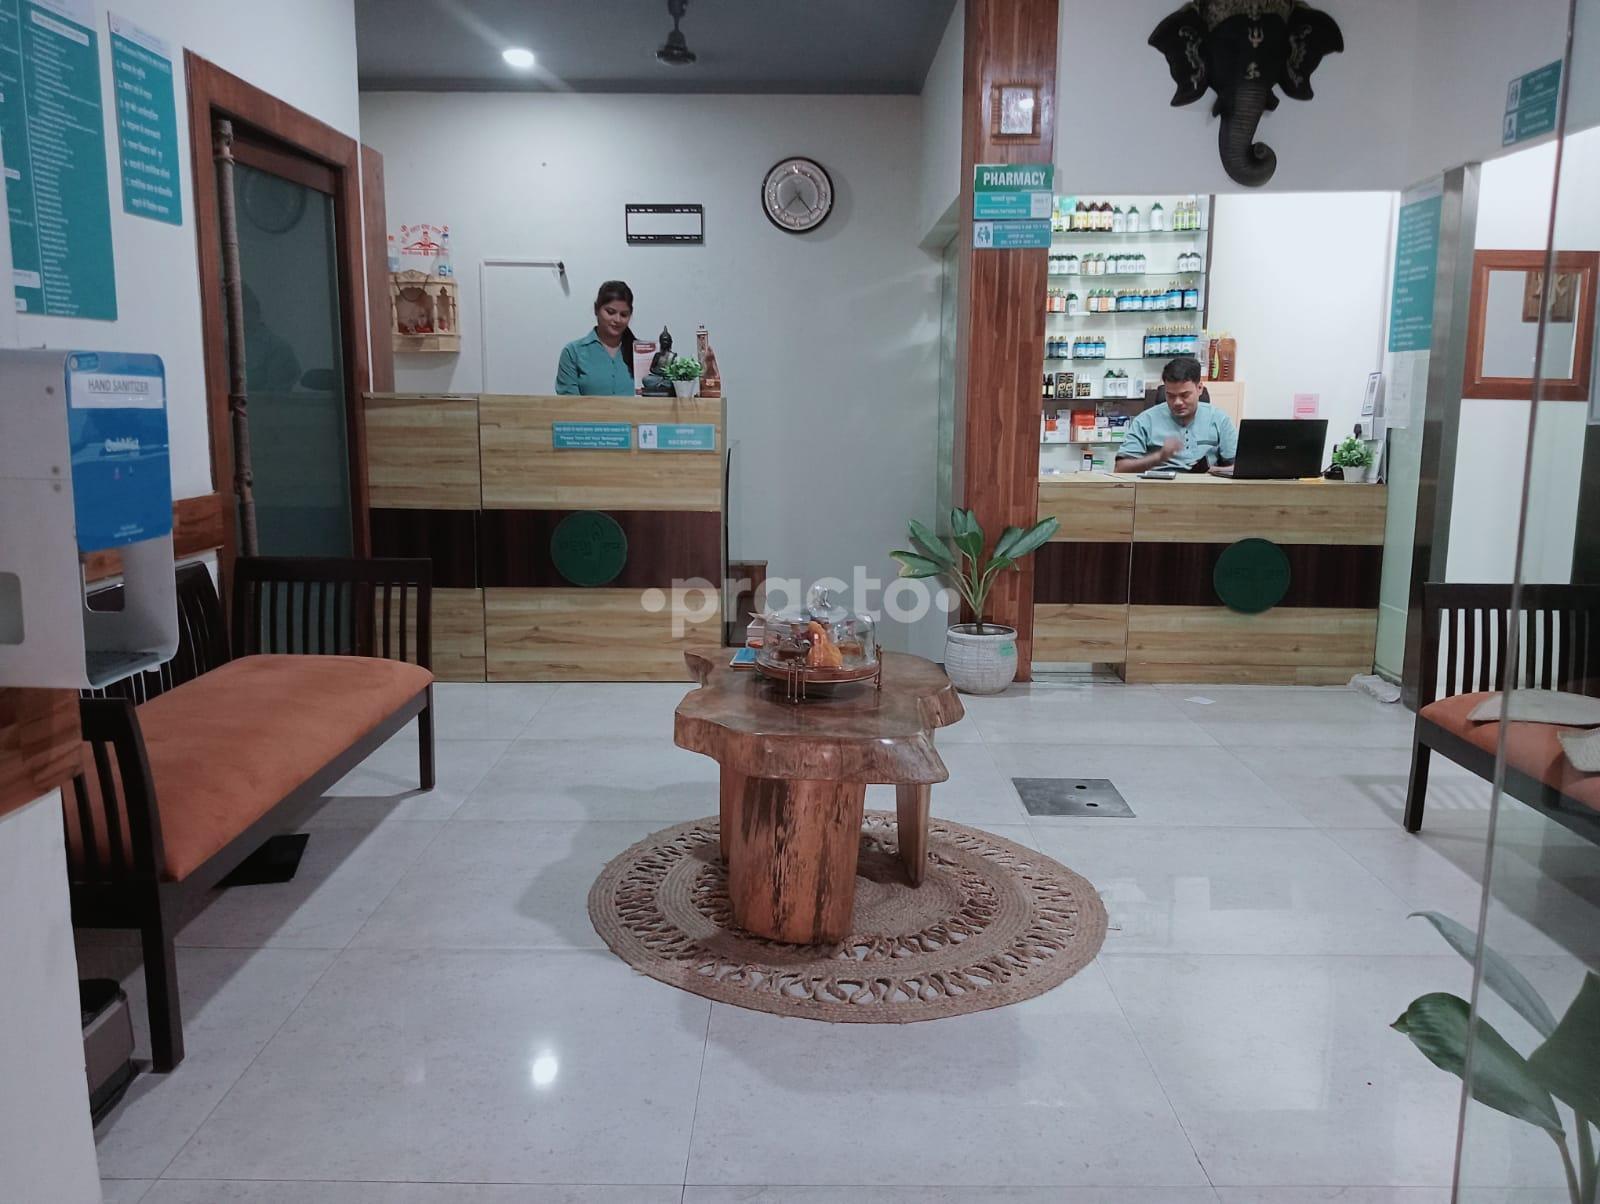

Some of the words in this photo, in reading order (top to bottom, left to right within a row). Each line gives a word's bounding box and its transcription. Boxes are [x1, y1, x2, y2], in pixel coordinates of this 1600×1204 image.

[983, 171, 1046, 186] PHARMACY
[88, 379, 111, 391] HAND
[112, 380, 149, 392] SANITIZER
